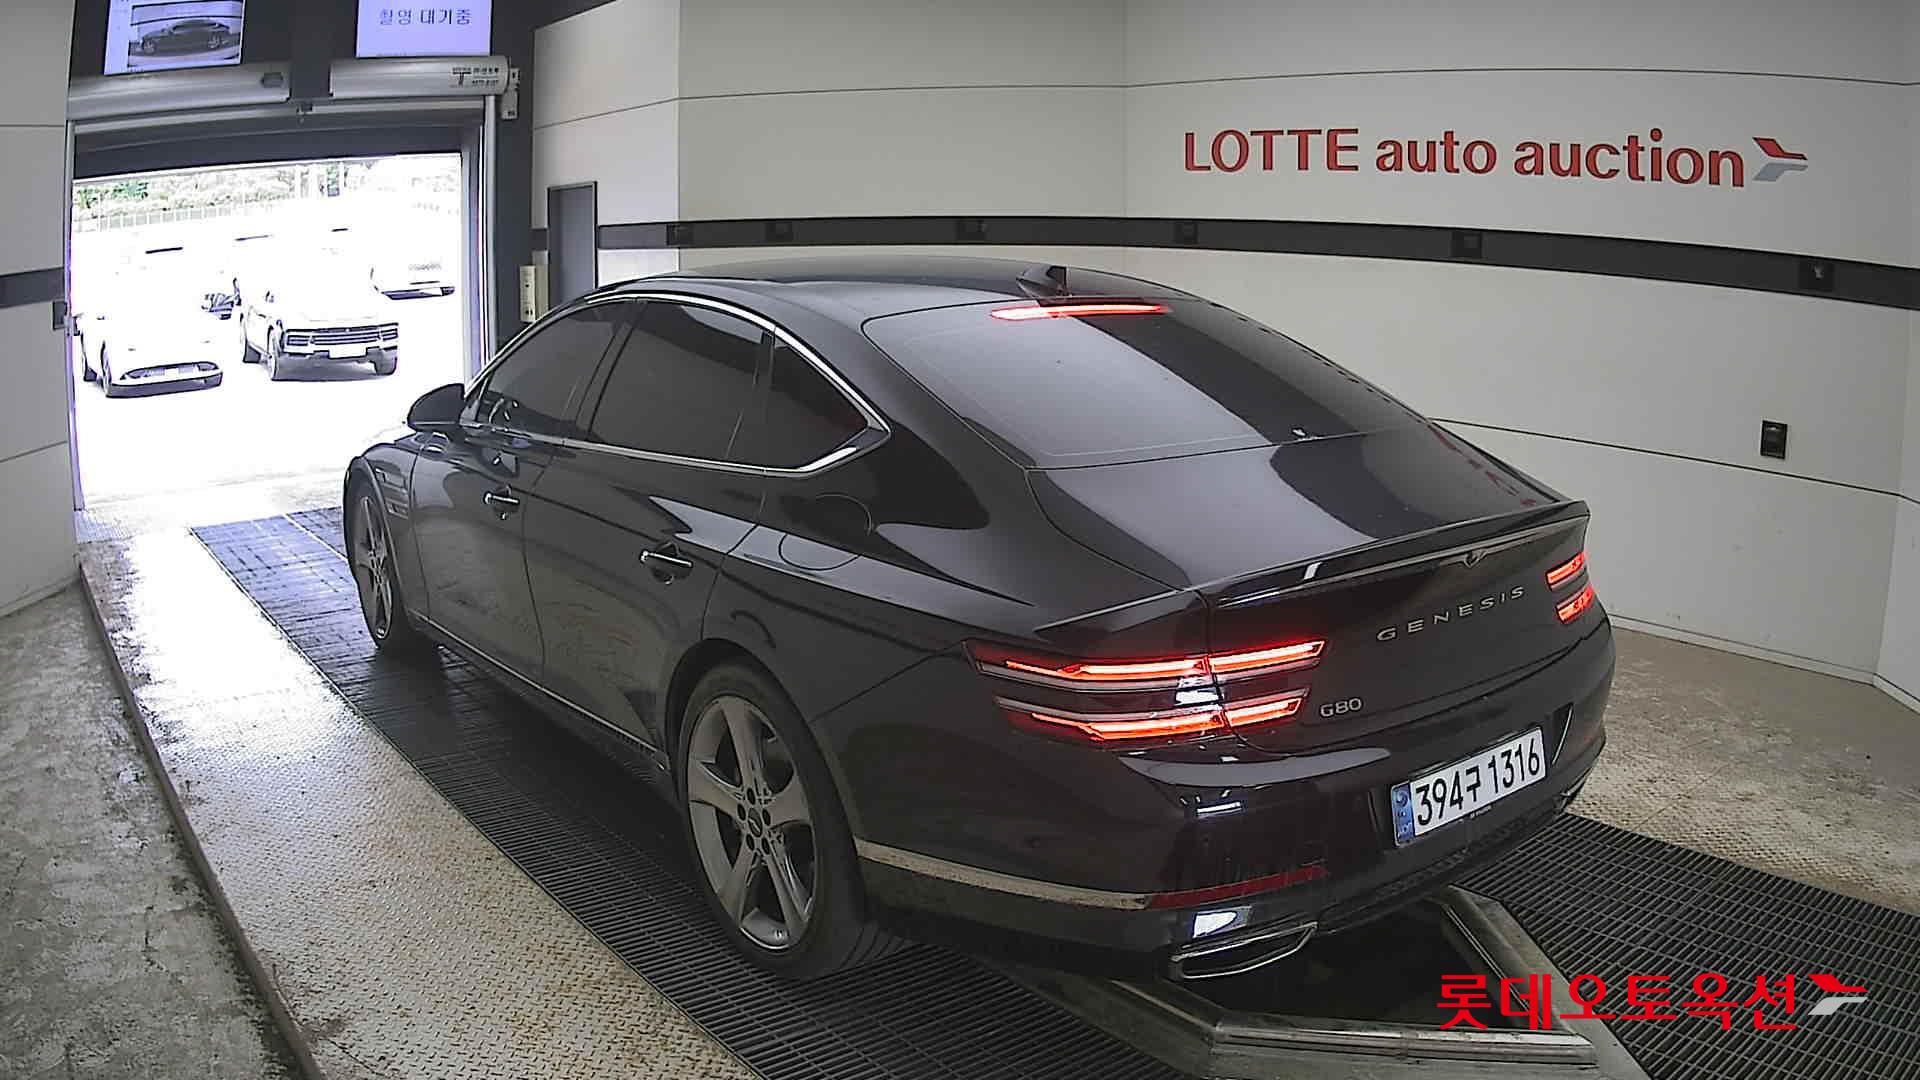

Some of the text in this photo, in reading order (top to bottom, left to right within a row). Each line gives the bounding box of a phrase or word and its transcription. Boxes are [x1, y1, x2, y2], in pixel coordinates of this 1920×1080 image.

[420, 9, 472, 25] 대기중
[1185, 128, 1745, 187] LOTTE auto auction
[1376, 587, 1524, 641] GENESIS
[1319, 698, 1363, 718] G80
[1415, 765, 1481, 826] 394구
[1488, 738, 1541, 794] 1316
